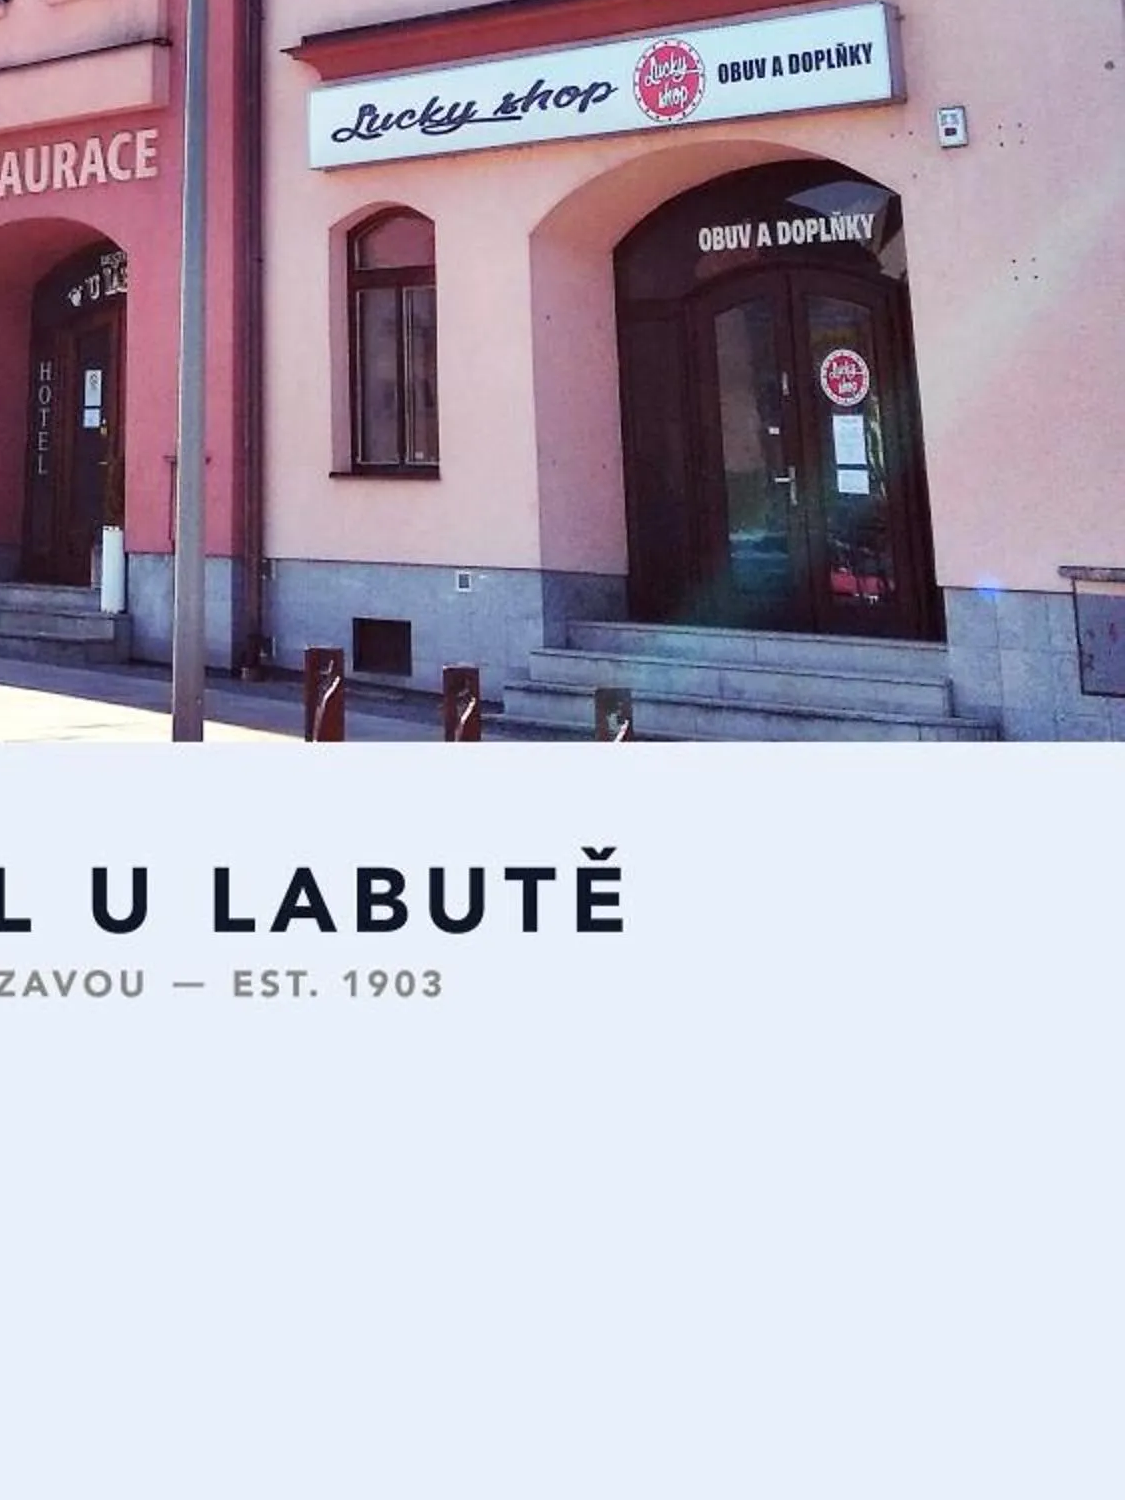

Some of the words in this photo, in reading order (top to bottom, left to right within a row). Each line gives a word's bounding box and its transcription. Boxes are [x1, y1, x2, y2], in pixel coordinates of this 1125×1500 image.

[644, 53, 701, 88] Lucky
[717, 57, 767, 85] OBUV
[771, 54, 784, 78] A
[788, 41, 873, 76] DOPLŇKY
[331, 94, 521, 143] Lucky
[492, 79, 618, 114] shop
[658, 84, 688, 109] shop
[698, 222, 752, 252] OBUV
[756, 221, 772, 247] A
[776, 210, 875, 246] DOPLŇKY
[37, 361, 53, 475] HOTEL
